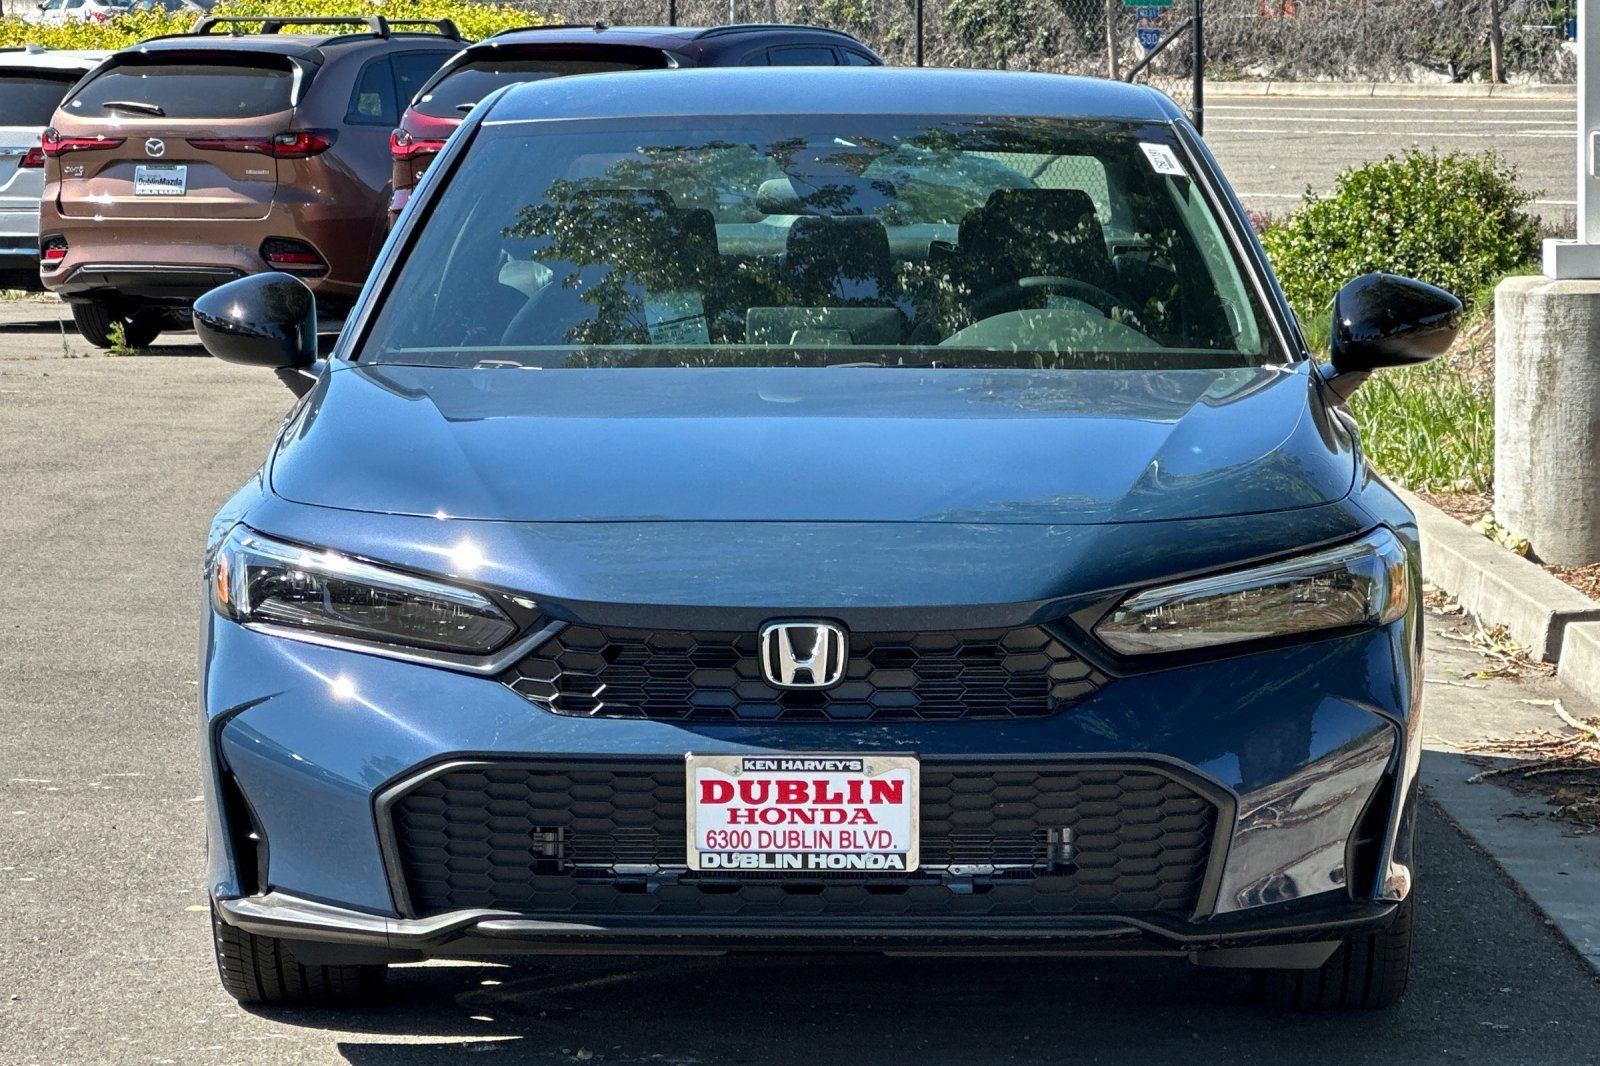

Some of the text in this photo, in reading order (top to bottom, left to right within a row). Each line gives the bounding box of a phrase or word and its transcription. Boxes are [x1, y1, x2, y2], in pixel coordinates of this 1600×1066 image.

[1141, 33, 1157, 44] 580
[743, 760, 862, 771] KEN HARVEY'S
[700, 780, 904, 804] DUBLIN
[727, 808, 877, 824] HONDA
[706, 830, 898, 849] 6300 DUBLIN BLVD.
[701, 853, 904, 869] DUBLIN HONDA
